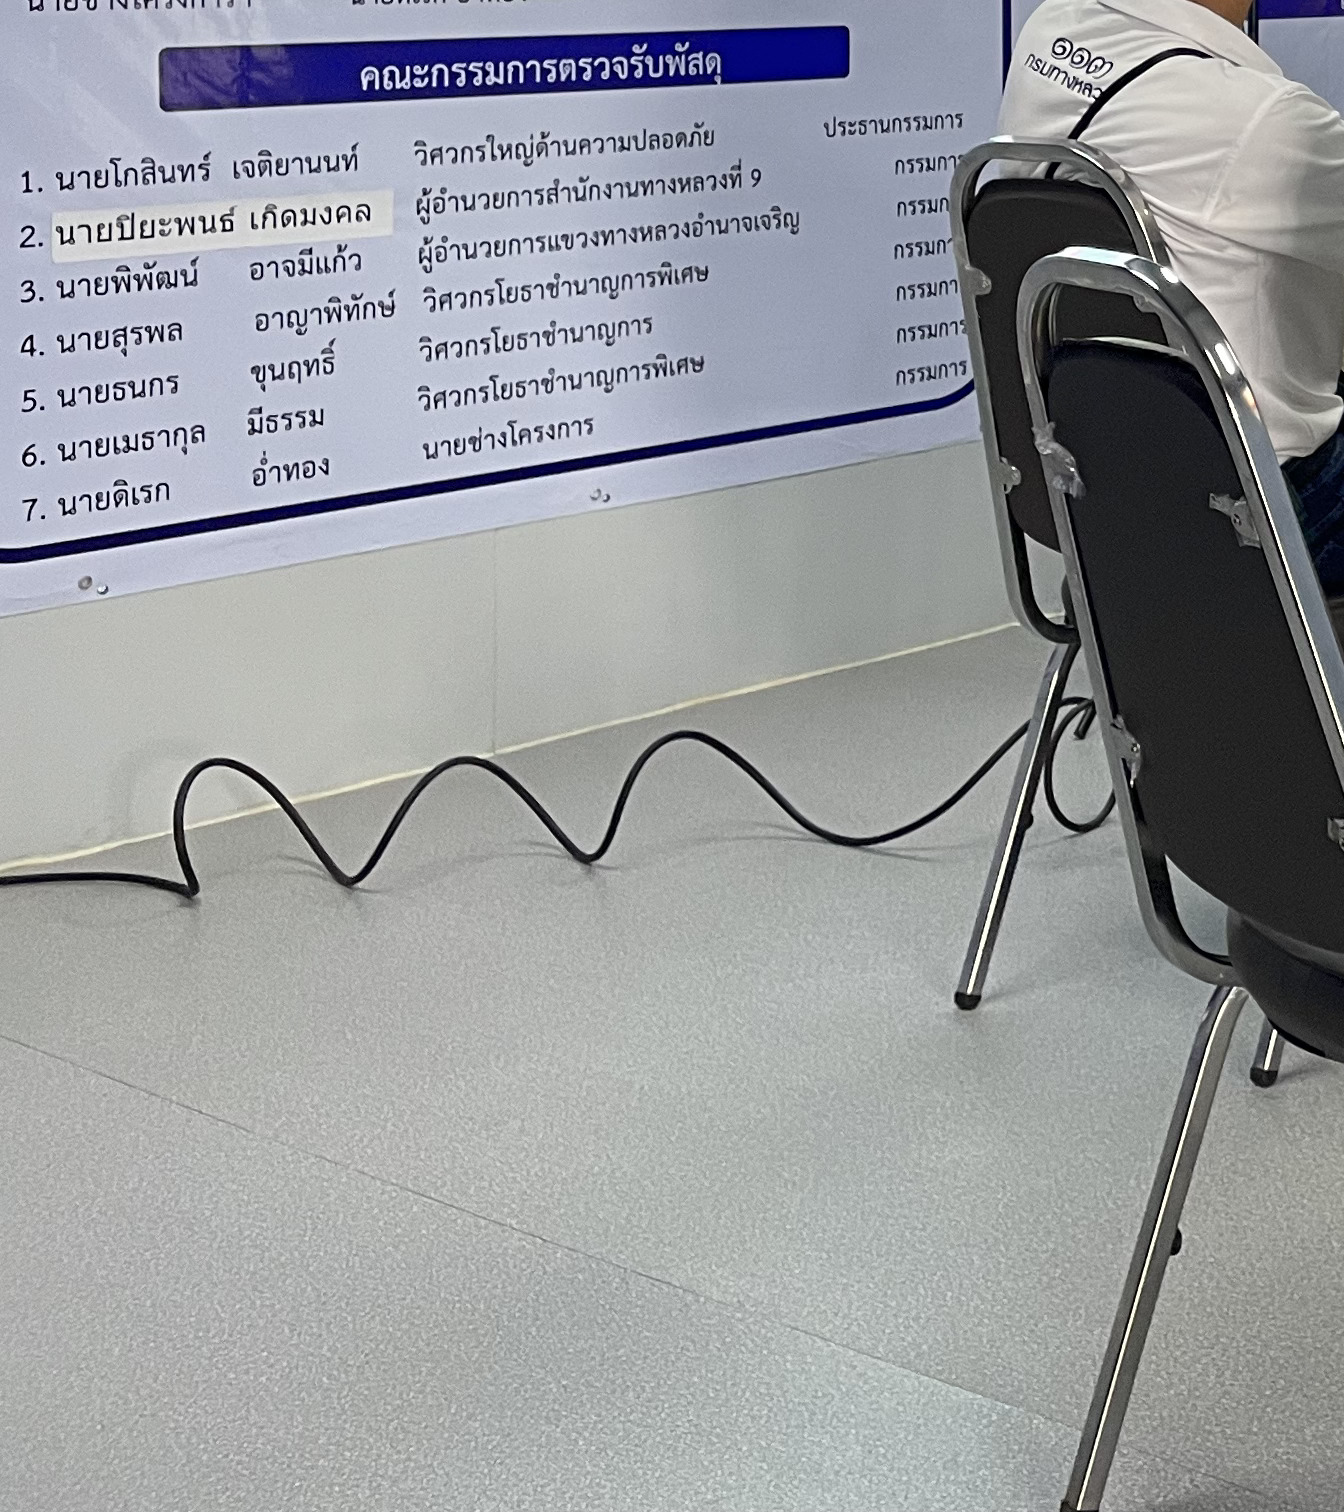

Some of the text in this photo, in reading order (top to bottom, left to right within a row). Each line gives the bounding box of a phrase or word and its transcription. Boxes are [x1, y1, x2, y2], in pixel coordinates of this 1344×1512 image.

[360, 41, 722, 91] คณะกรรมการตรวจรับพัสดุ
[1024, 53, 1103, 99] กรมทางหลว
[21, 110, 964, 193] 1. นายโกสินทร์ เจติยานนท์ วิศวกรใหญ่ด้านความปลอดภัย ประธานกรรมการ
[19, 225, 44, 249] 2.
[55, 206, 236, 247] นายปิยะพนธ์
[249, 200, 372, 231] เกิดมงคล
[416, 159, 743, 224] ผู้อำนวยการสำนักงานทางหลวงที่
[750, 168, 763, 189] 9
[20, 280, 44, 303] 3.
[56, 256, 199, 299] นายพิพัฒน์
[249, 245, 363, 280] อาจมีแก้ว
[417, 205, 801, 273] ผู้อำนวยการแขวงทางหลวงอำนาจเจริญ
[20, 335, 44, 357] 4.
[56, 321, 183, 358] นายสุรพล
[255, 290, 396, 335] อาญาพิทักษ์
[423, 260, 710, 313] วิศวกรโยธาชำนาญการพิเศษ
[21, 278, 958, 412] 5. นายธนกร ขุนฤทธิ์ วิศวกรโยธาชำนาญการ กรรมกา
[21, 444, 46, 468] 6.
[57, 422, 206, 462] นายเมธากุล
[247, 406, 325, 437] มีธรรม
[417, 350, 705, 413] วิศวกรโยธาชำนาญการพิเศษ
[22, 359, 967, 522] 7. นายดิเรก อ่ำทอง นายช่างโครงการ กรรมการ
